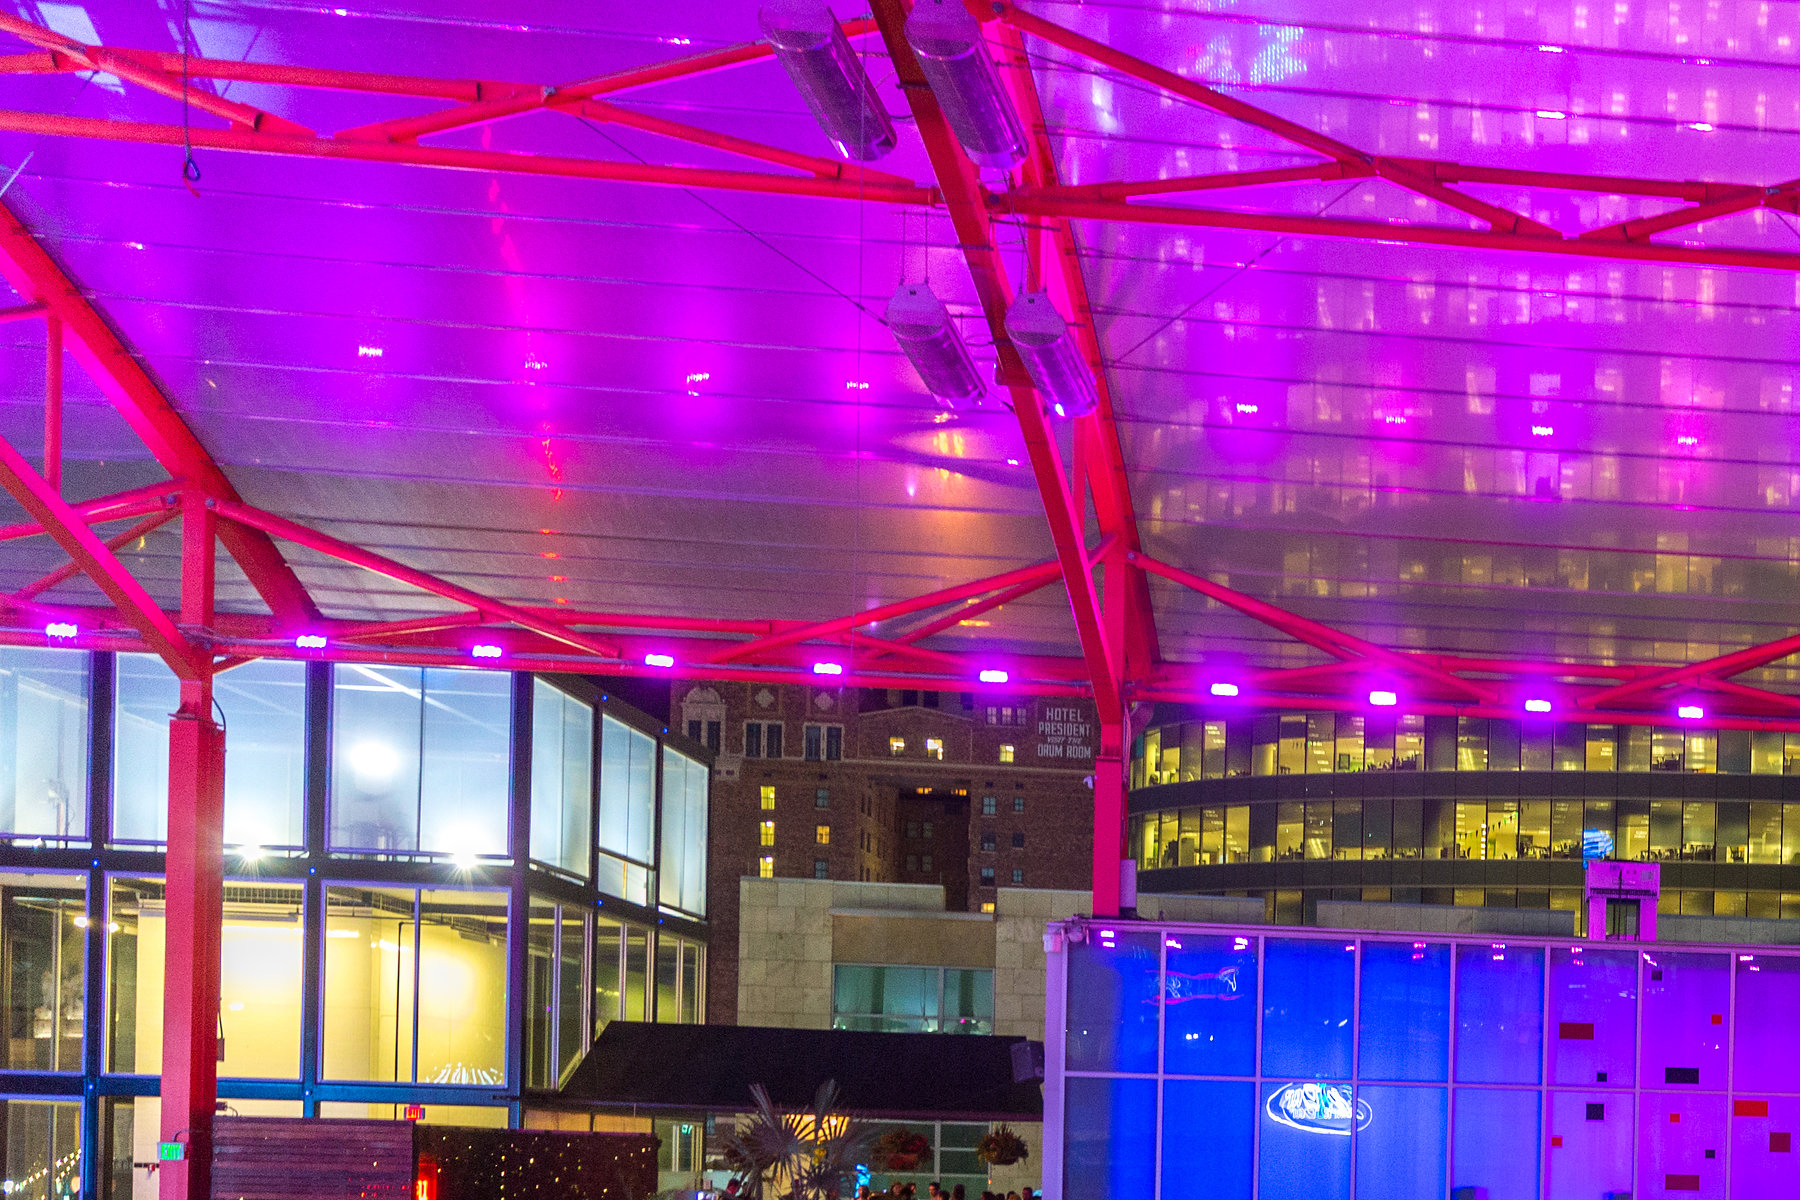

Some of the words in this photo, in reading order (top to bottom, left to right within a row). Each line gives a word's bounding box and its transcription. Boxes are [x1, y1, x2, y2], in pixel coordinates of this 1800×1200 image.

[1046, 707, 1084, 722] HOTEL
[1038, 721, 1091, 737] PRESIDENT
[1037, 744, 1063, 757] DRUM
[1067, 745, 1091, 759] ROOM
[160, 1143, 181, 1160] EXIT
